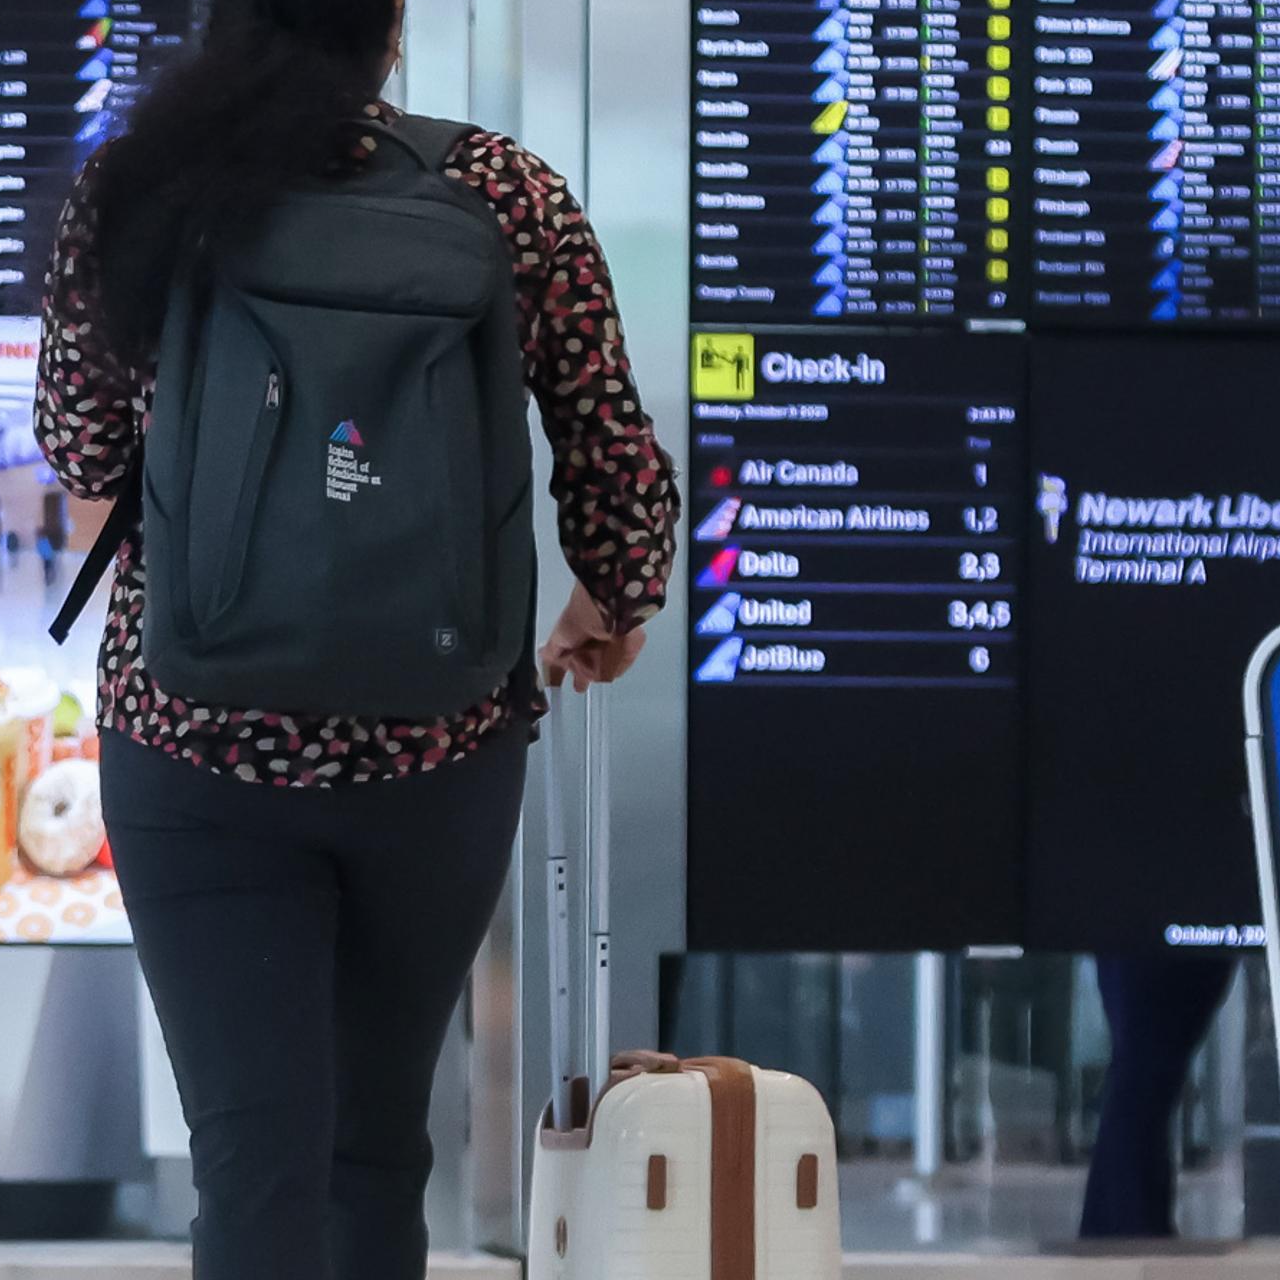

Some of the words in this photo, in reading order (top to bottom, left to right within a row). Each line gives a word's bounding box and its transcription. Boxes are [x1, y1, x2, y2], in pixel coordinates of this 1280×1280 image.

[761, 352, 886, 384] Check-in
[328, 455, 357, 473] School
[360, 462, 370, 472] of
[738, 460, 774, 485] Air
[775, 460, 859, 486] Canada
[973, 462, 989, 487] 1
[739, 504, 844, 530] American
[845, 504, 931, 532] Airlines
[1077, 492, 1215, 527] Newark
[1078, 528, 1229, 557] International
[738, 550, 800, 578] Delta
[1075, 555, 1184, 584] Terminal
[1187, 558, 1207, 584] A
[738, 598, 813, 626] United
[739, 644, 826, 672] JetBlue
